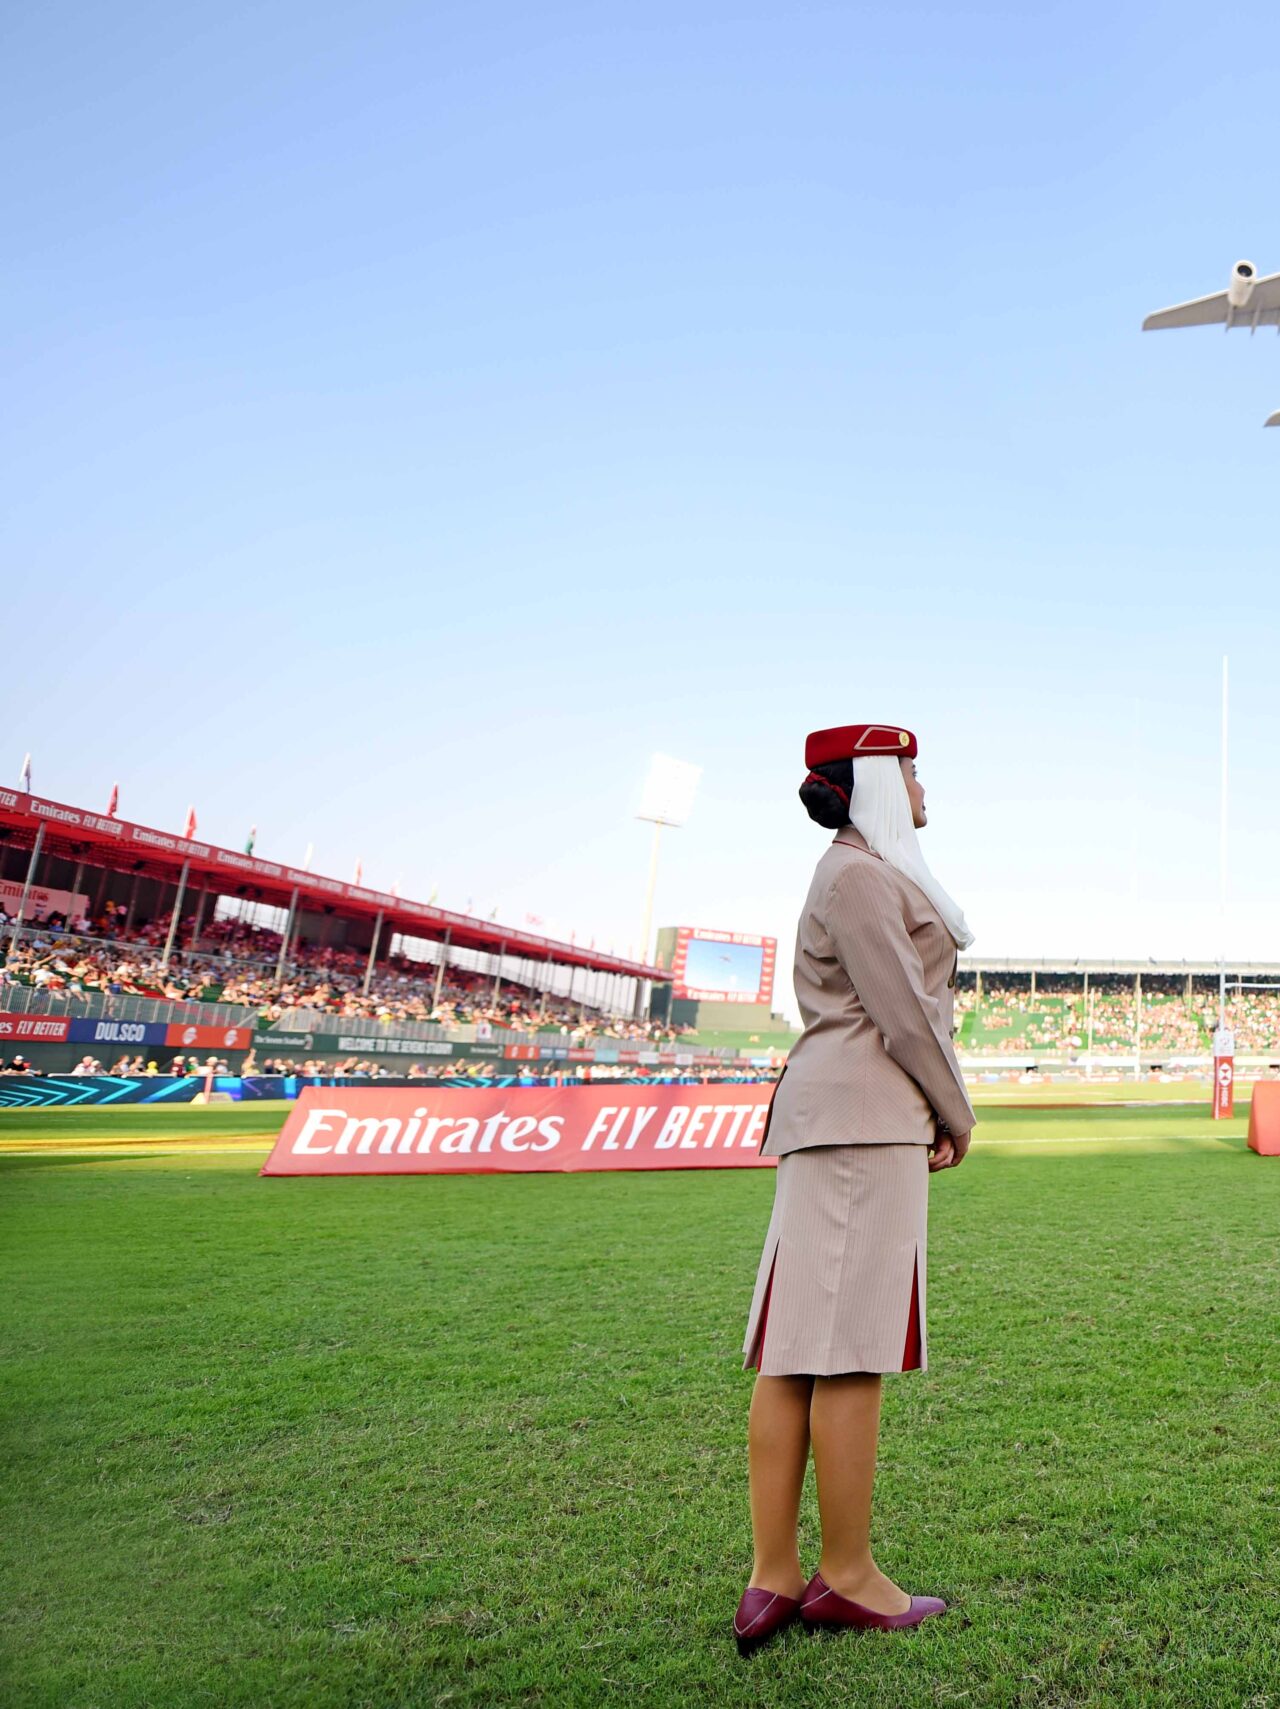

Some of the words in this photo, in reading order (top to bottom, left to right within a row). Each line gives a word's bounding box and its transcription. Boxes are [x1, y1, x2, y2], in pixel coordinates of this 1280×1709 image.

[31, 800, 80, 824] Emirates
[16, 1020, 34, 1035] FLY
[33, 1021, 67, 1037] BETTER
[95, 1022, 146, 1042] DULSCO
[291, 1106, 565, 1155] Emirates
[580, 1106, 658, 1151] FLY
[653, 1104, 770, 1149] BETTE
